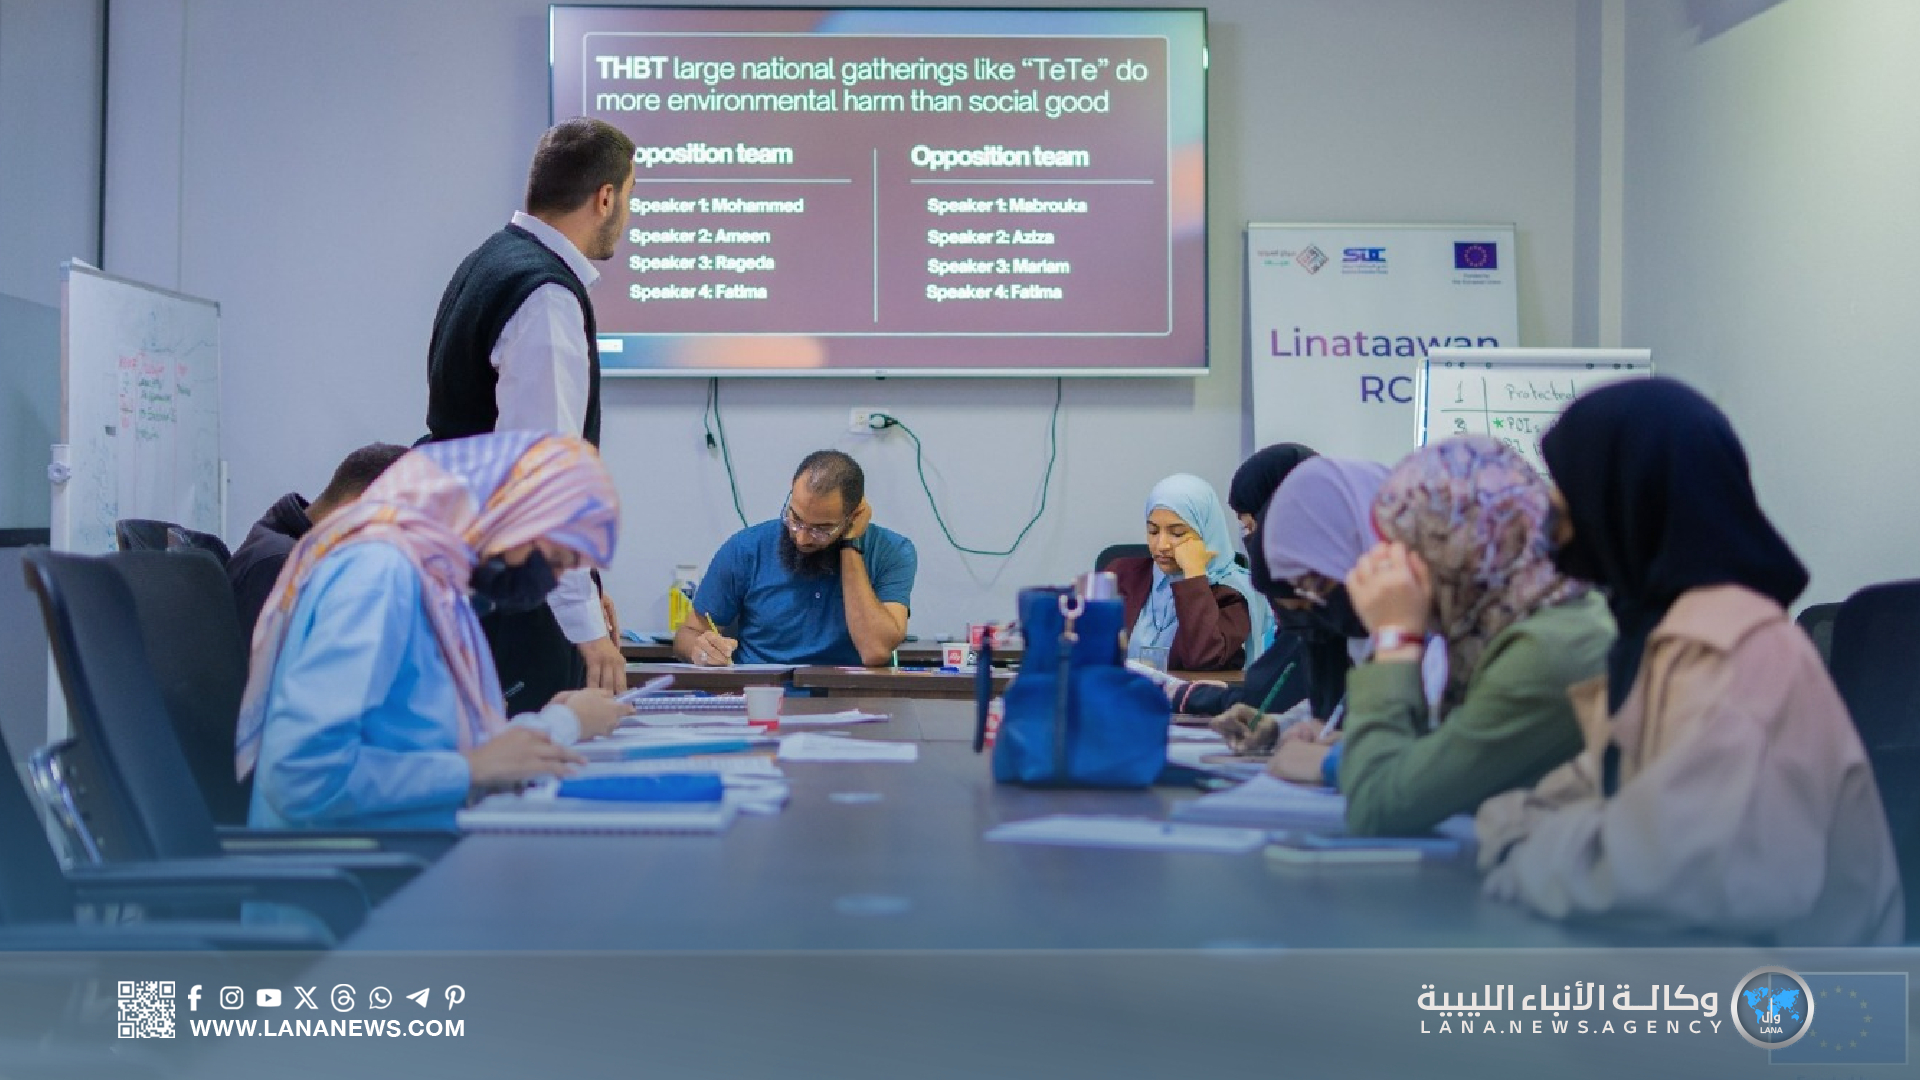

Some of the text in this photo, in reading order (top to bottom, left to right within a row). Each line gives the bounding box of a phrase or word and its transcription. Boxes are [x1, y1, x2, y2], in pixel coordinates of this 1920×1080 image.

[596, 55, 1148, 87] THBT large national gatherings like “TeTe” do
[596, 88, 1110, 118] more environmental harm than social good
[734, 142, 794, 165] team
[910, 144, 1090, 171] Opposition team
[629, 197, 805, 216] Speaker 1: Mohammed
[927, 197, 1088, 216] Speaker 1: Mabrouka
[629, 228, 771, 247] Speaker 2: Ameen
[927, 229, 1055, 247] Speaker 2: Aziza
[629, 255, 775, 274] Speaker 3: Rageda
[927, 257, 1070, 276] Speaker 3: Mariam
[629, 283, 768, 302] Speaker 4: Fatima
[926, 283, 1063, 302] Speaker 4: Fatima
